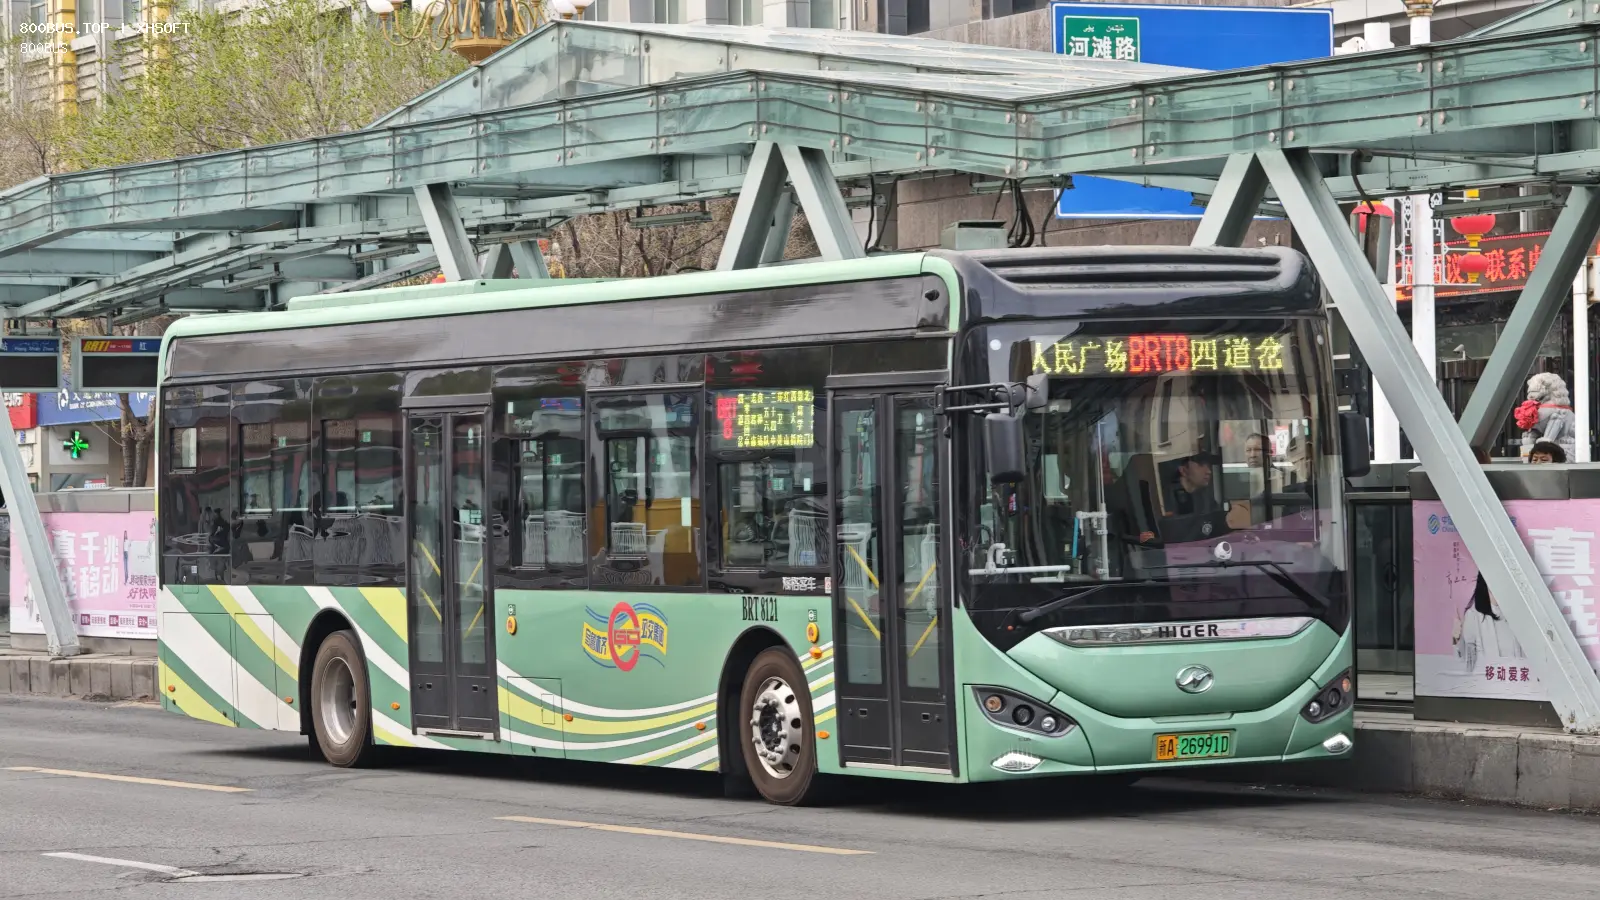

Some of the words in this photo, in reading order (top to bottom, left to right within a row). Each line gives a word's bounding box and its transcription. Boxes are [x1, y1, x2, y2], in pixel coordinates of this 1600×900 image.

[1069, 36, 1136, 60] 河滩路
[1032, 340, 1127, 373] 人民广场
[1128, 334, 1190, 372] BRT8
[52, 529, 120, 564] 真千兆
[1528, 527, 1594, 586] 真
[742, 596, 759, 621] BRT
[761, 597, 778, 622] 8121
[1159, 624, 1219, 639] HIGER
[1485, 665, 1530, 682] 移动爱家
